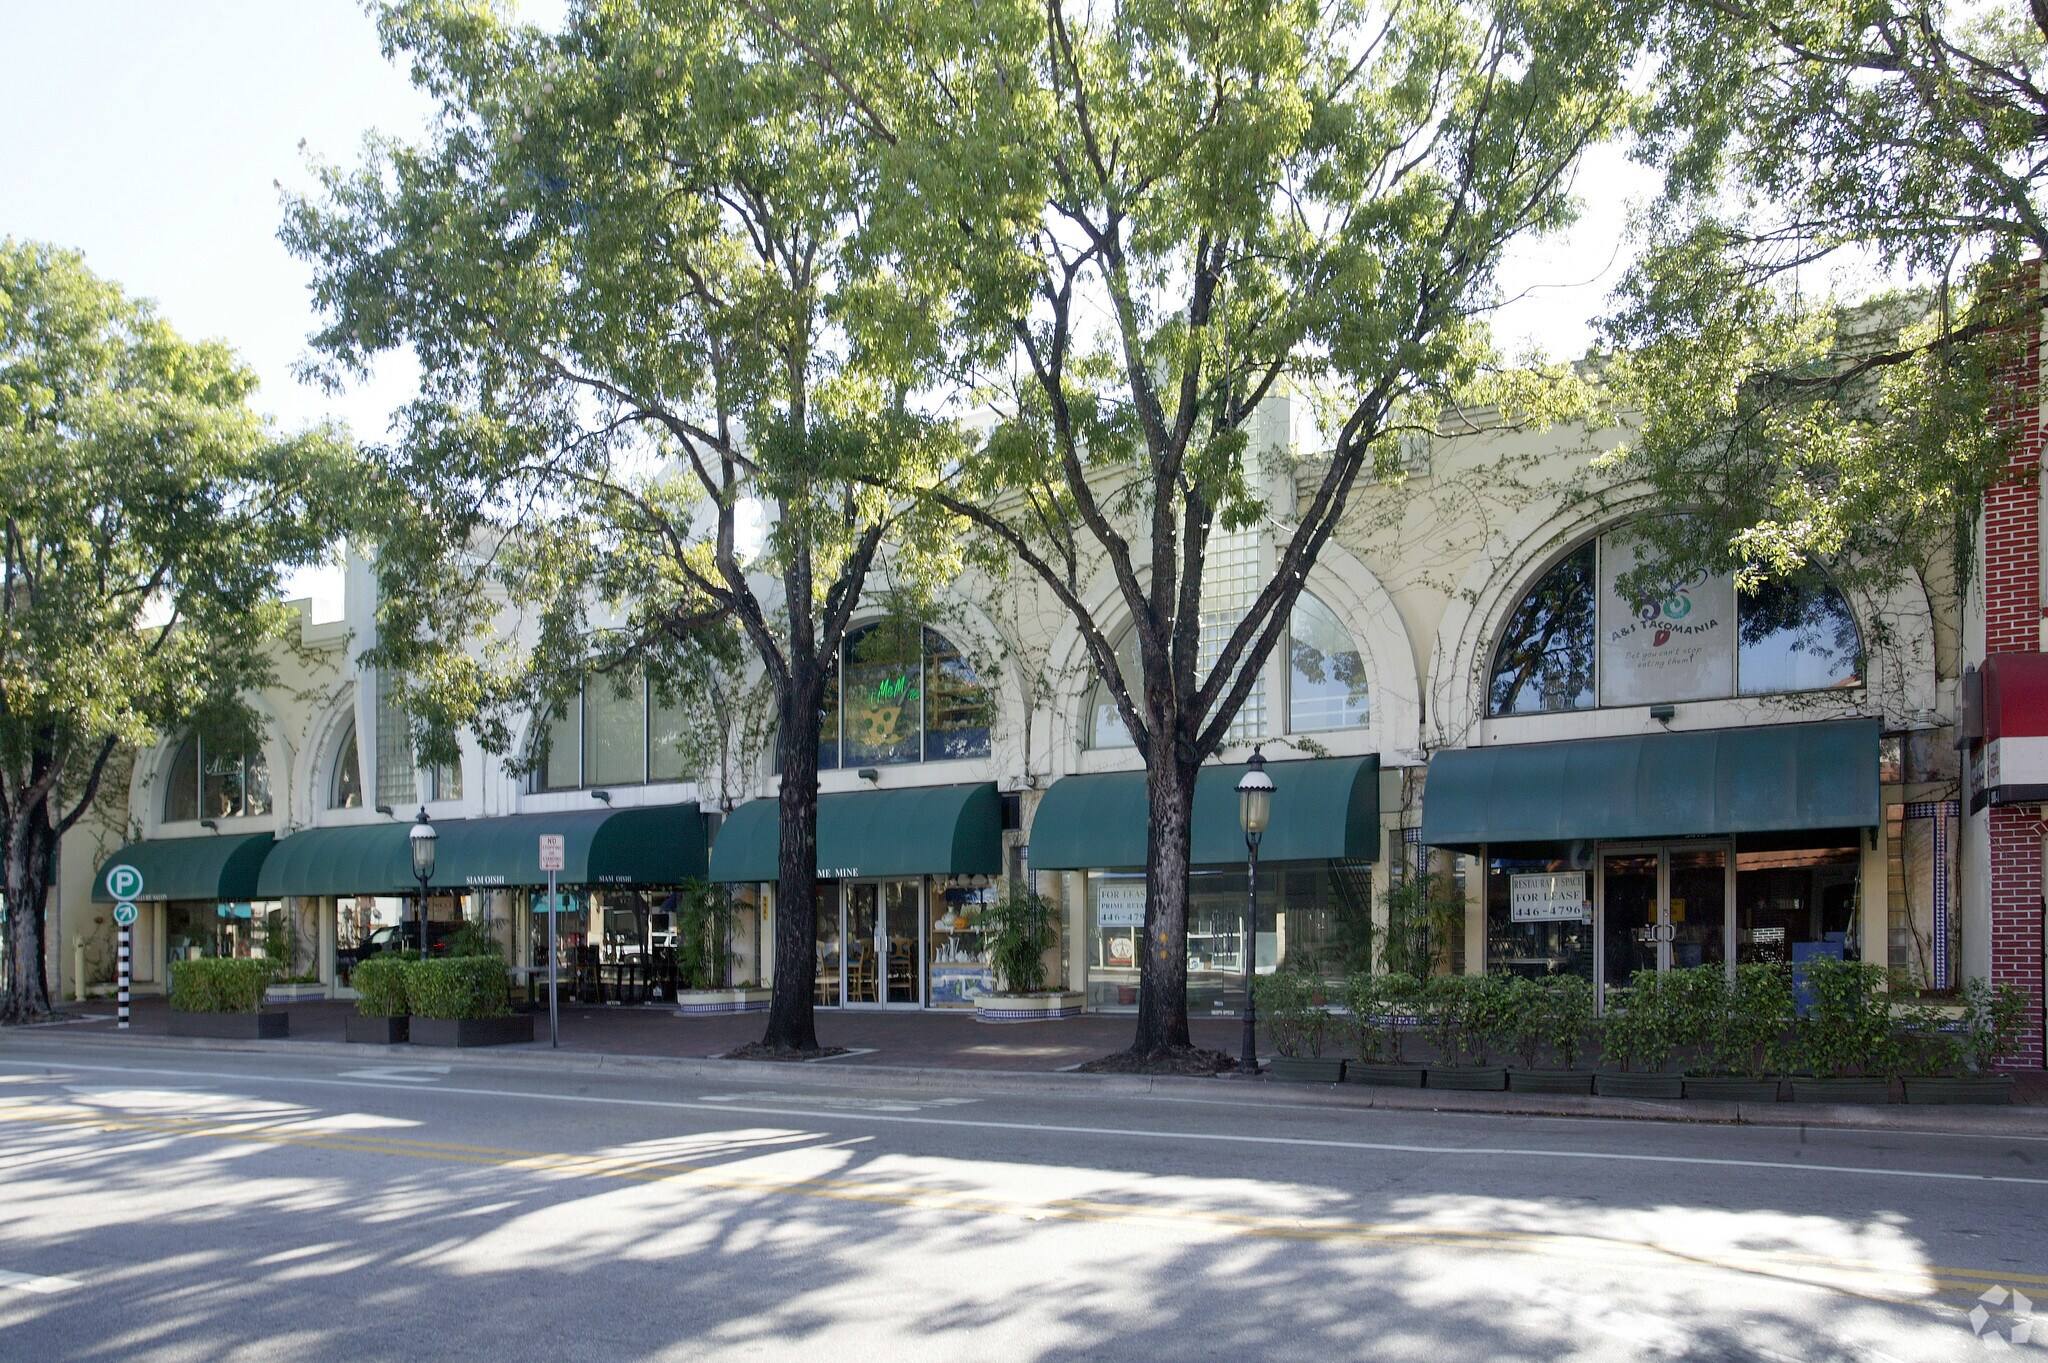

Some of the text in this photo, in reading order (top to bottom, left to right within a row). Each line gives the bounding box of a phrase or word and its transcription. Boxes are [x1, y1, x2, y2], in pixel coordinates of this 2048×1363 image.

[1611, 619, 1718, 642] A&S TACOMANIA
[1642, 652, 1657, 661] you
[1658, 648, 1680, 656] can't
[1683, 646, 1702, 655] stop
[1637, 660, 1665, 669] eating
[547, 837, 557, 845] NO
[817, 867, 859, 878] ME MINE
[116, 871, 134, 894] P
[466, 875, 505, 885] SIAM OISHI
[598, 875, 632, 883] SIAM OISHI
[1560, 876, 1582, 887] SPACE
[1101, 890, 1146, 899] FOR LEAS
[1516, 891, 1580, 902] FOR LEASE
[1101, 902, 1124, 910] PRIME
[1516, 906, 1581, 916] 446-4796
[1101, 912, 1145, 921] 446-479
